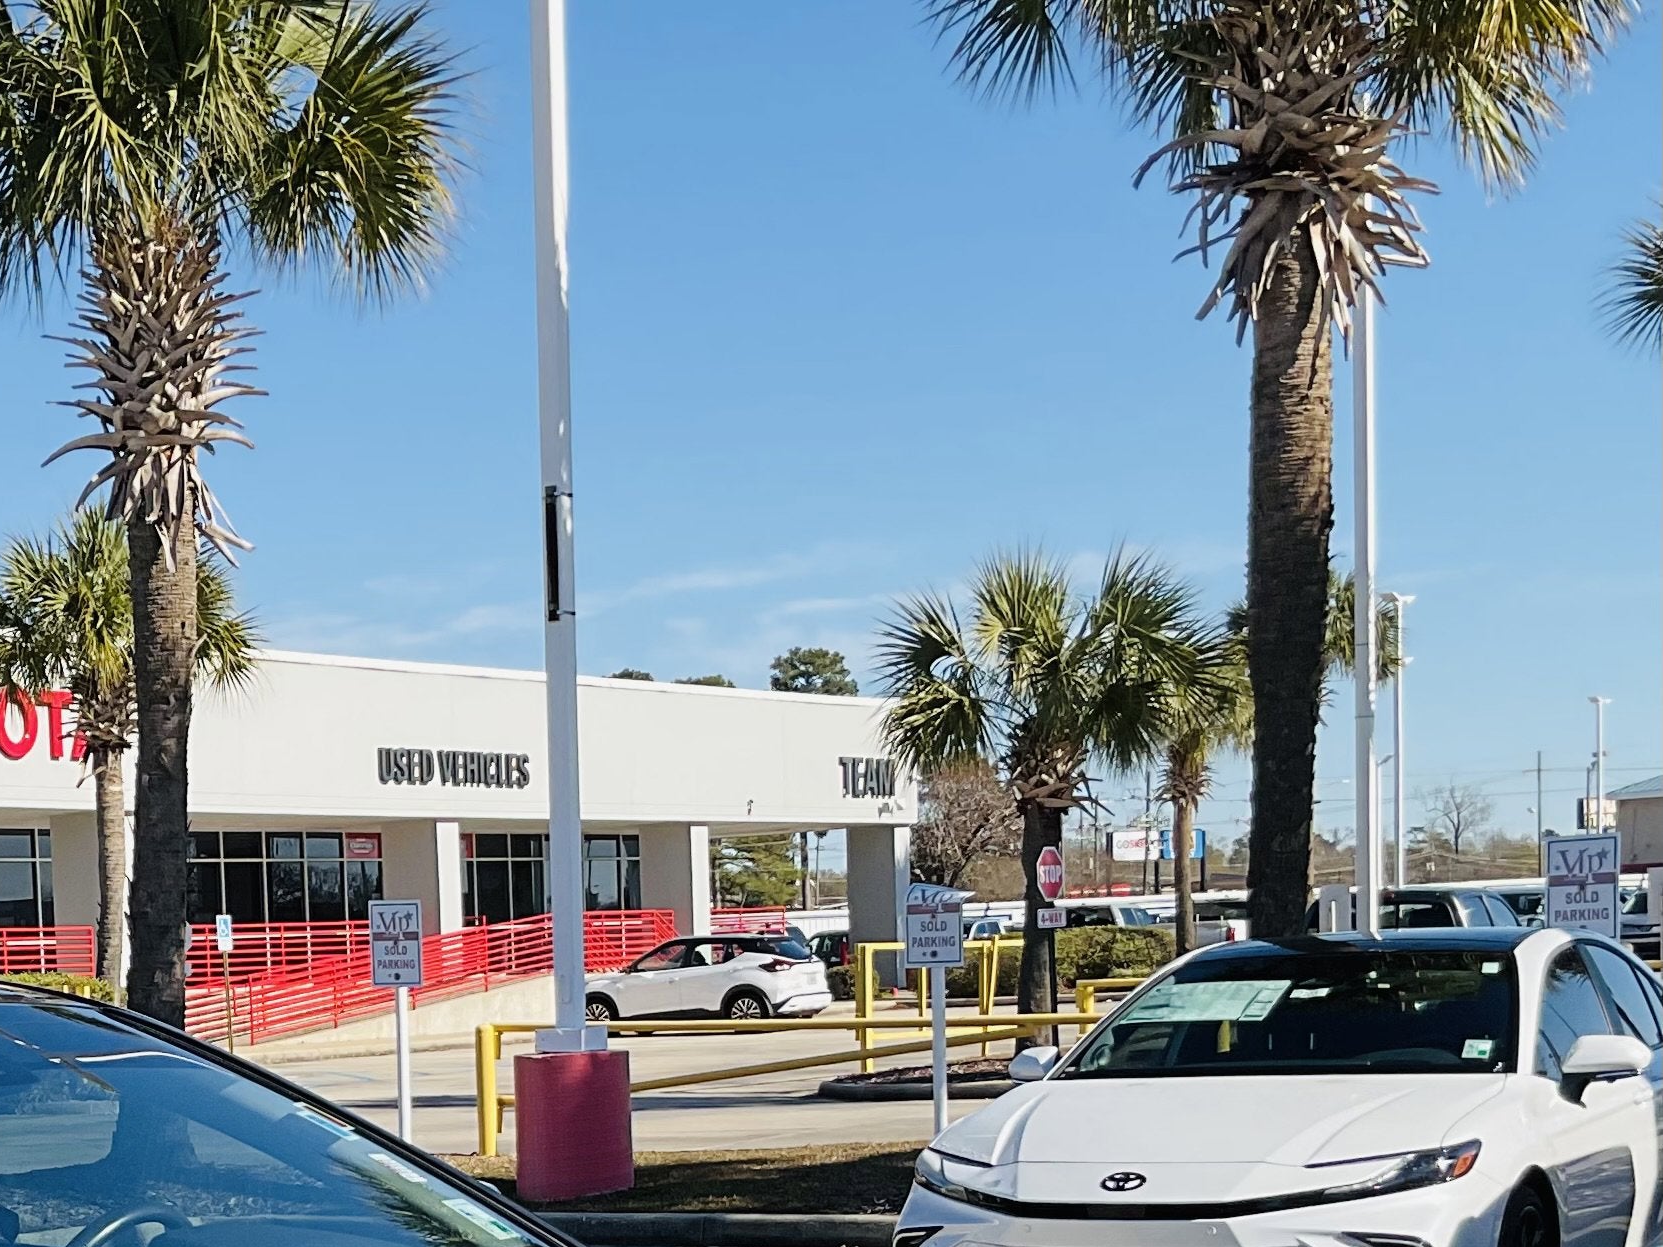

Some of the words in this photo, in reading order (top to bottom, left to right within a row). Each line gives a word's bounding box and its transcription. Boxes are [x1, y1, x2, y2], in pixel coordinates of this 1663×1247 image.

[377, 747, 435, 785] USED
[436, 750, 530, 789] VEHICLES
[838, 757, 896, 799] TEAM
[1039, 865, 1062, 884] STOP
[1565, 891, 1599, 905] SOLD
[1040, 912, 1063, 924] 4-WAY
[1554, 908, 1610, 922] PARKING
[920, 920, 948, 932] SOLD
[911, 936, 956, 948] PARKING
[384, 945, 408, 956] SOLD
[377, 959, 416, 969] PARKING
